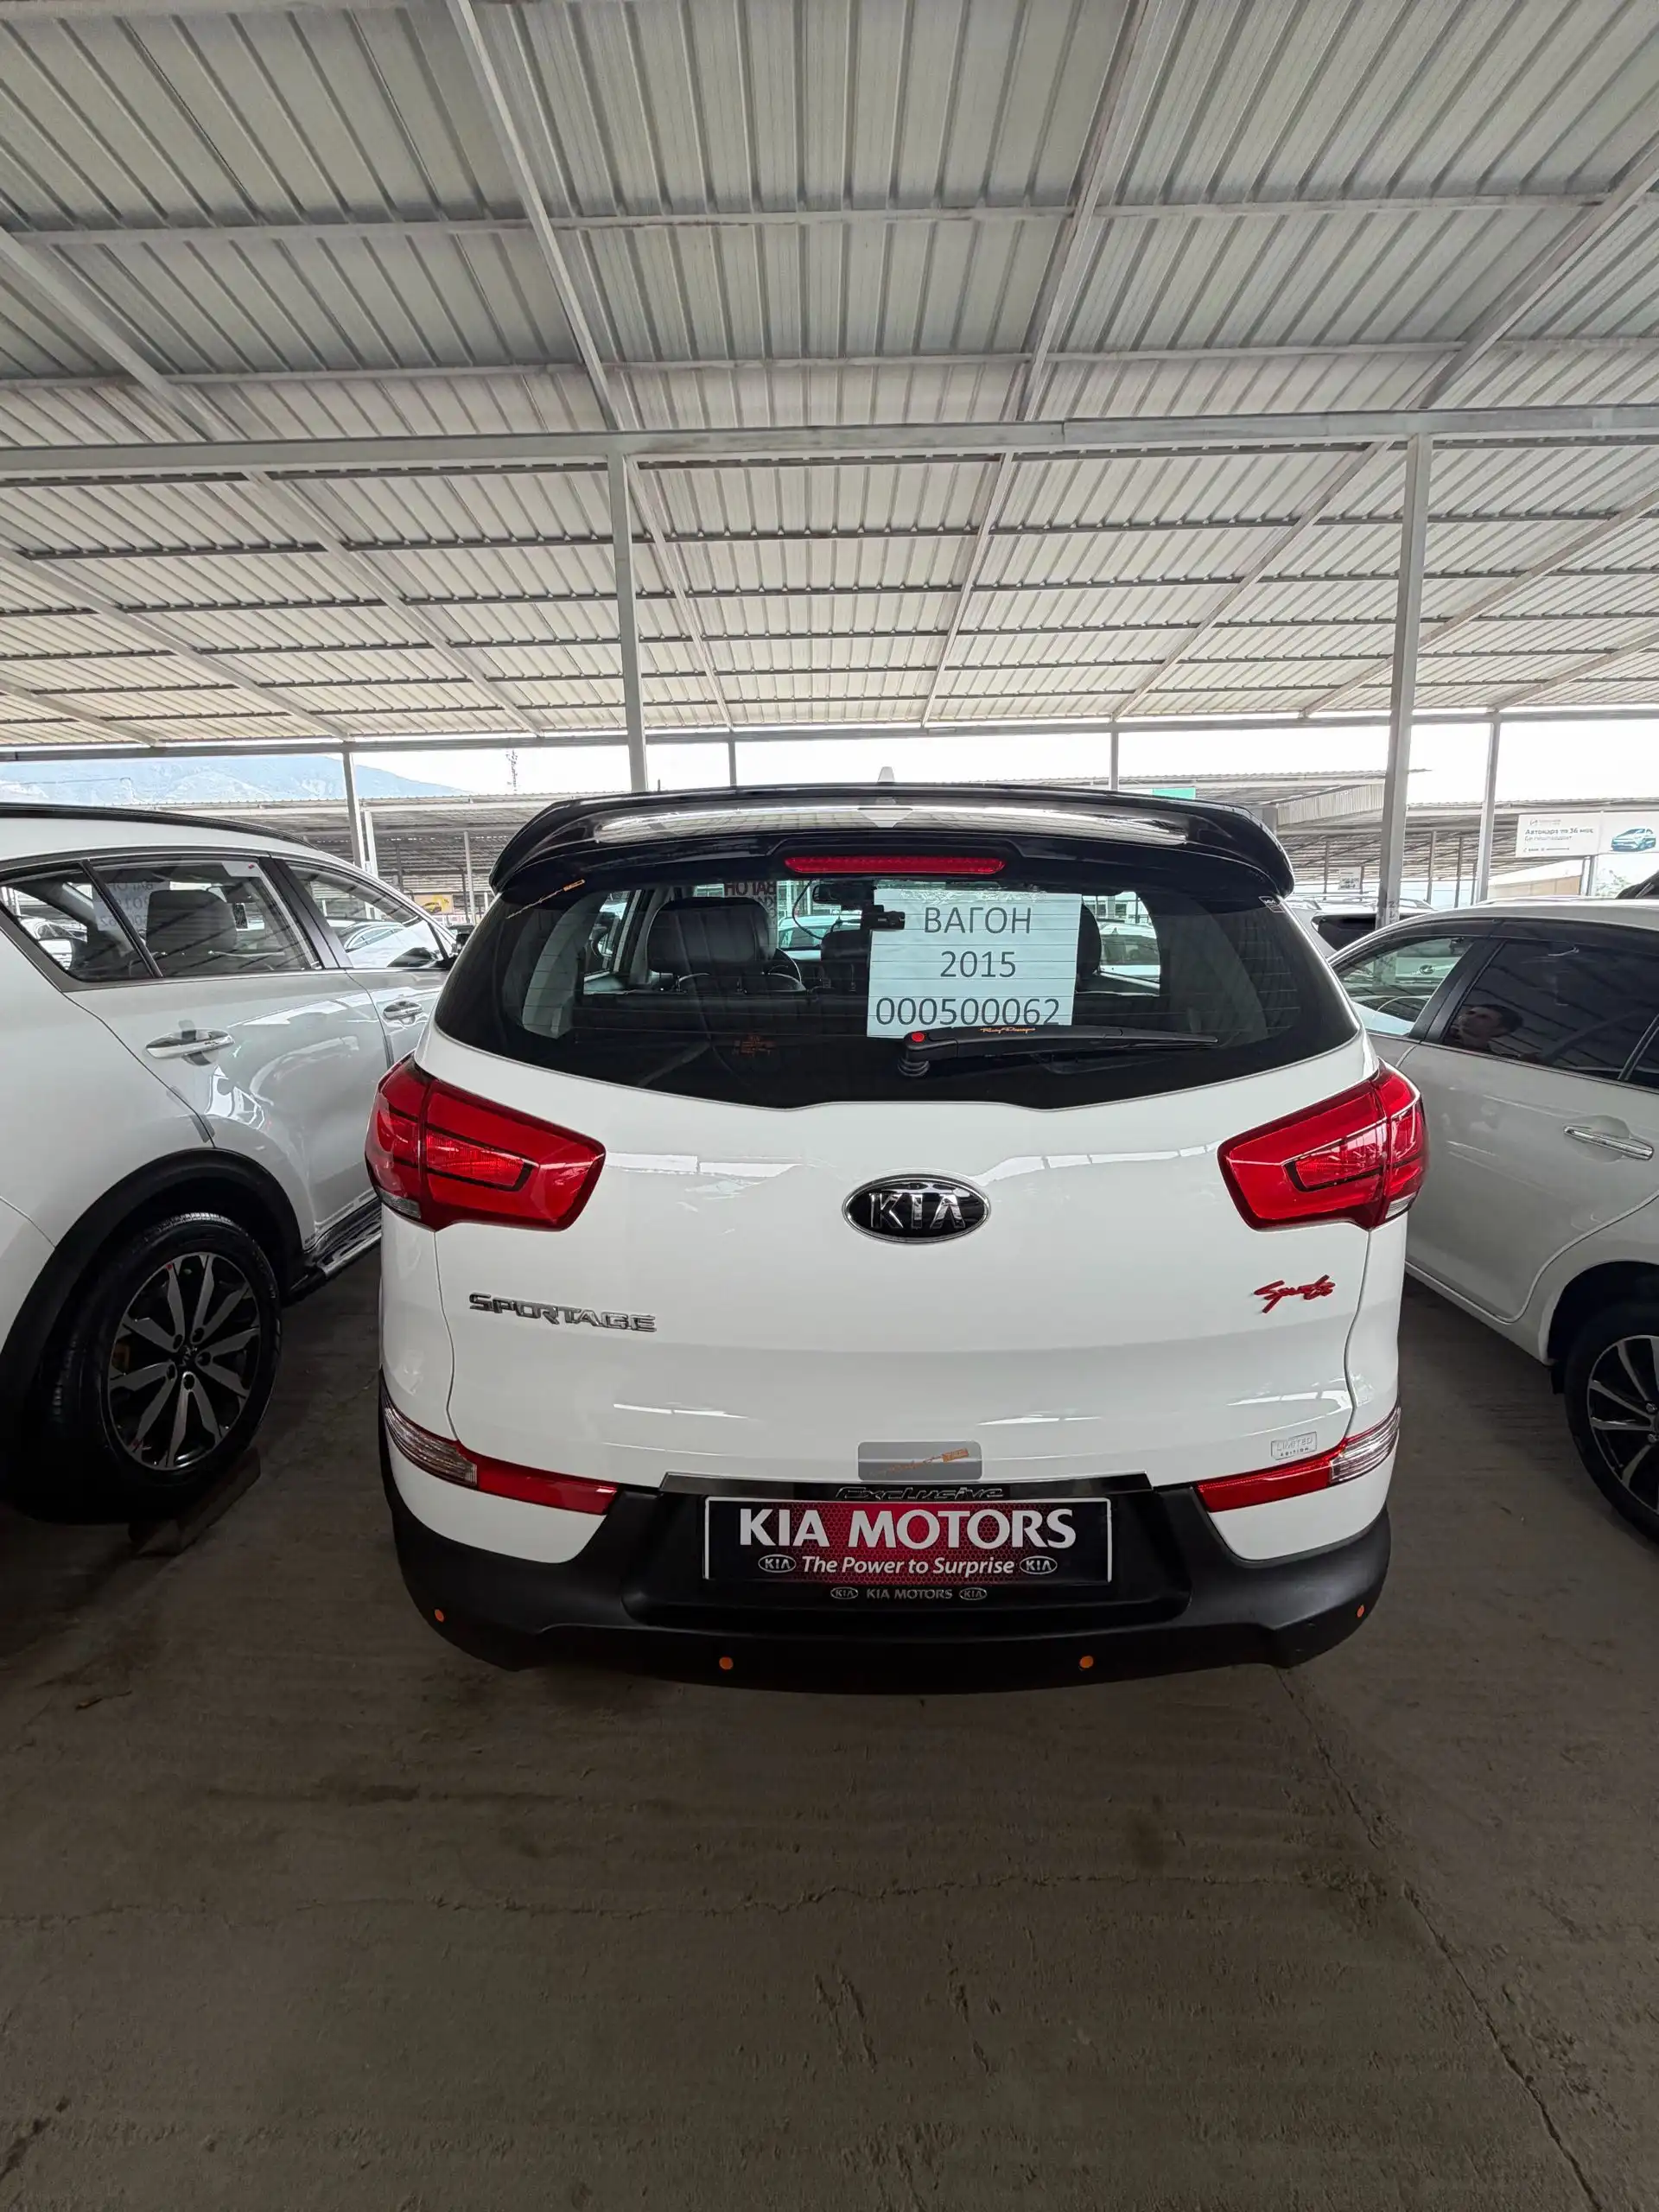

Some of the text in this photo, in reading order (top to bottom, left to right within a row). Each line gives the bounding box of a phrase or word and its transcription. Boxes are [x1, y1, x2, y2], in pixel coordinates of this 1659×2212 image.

[925, 907, 1032, 934] ВАГОН
[940, 950, 1016, 978] 2015
[875, 997, 1060, 1026] 000500062
[868, 1192, 966, 1229] KIA
[469, 1293, 657, 1332] SPORTAGE
[740, 1508, 1077, 1550] KIA MOTORS
[764, 1555, 1052, 1578] KIA The Power to Surprise KIA
[867, 1588, 890, 1599] KIA
[894, 1588, 952, 1599] MOTORS
